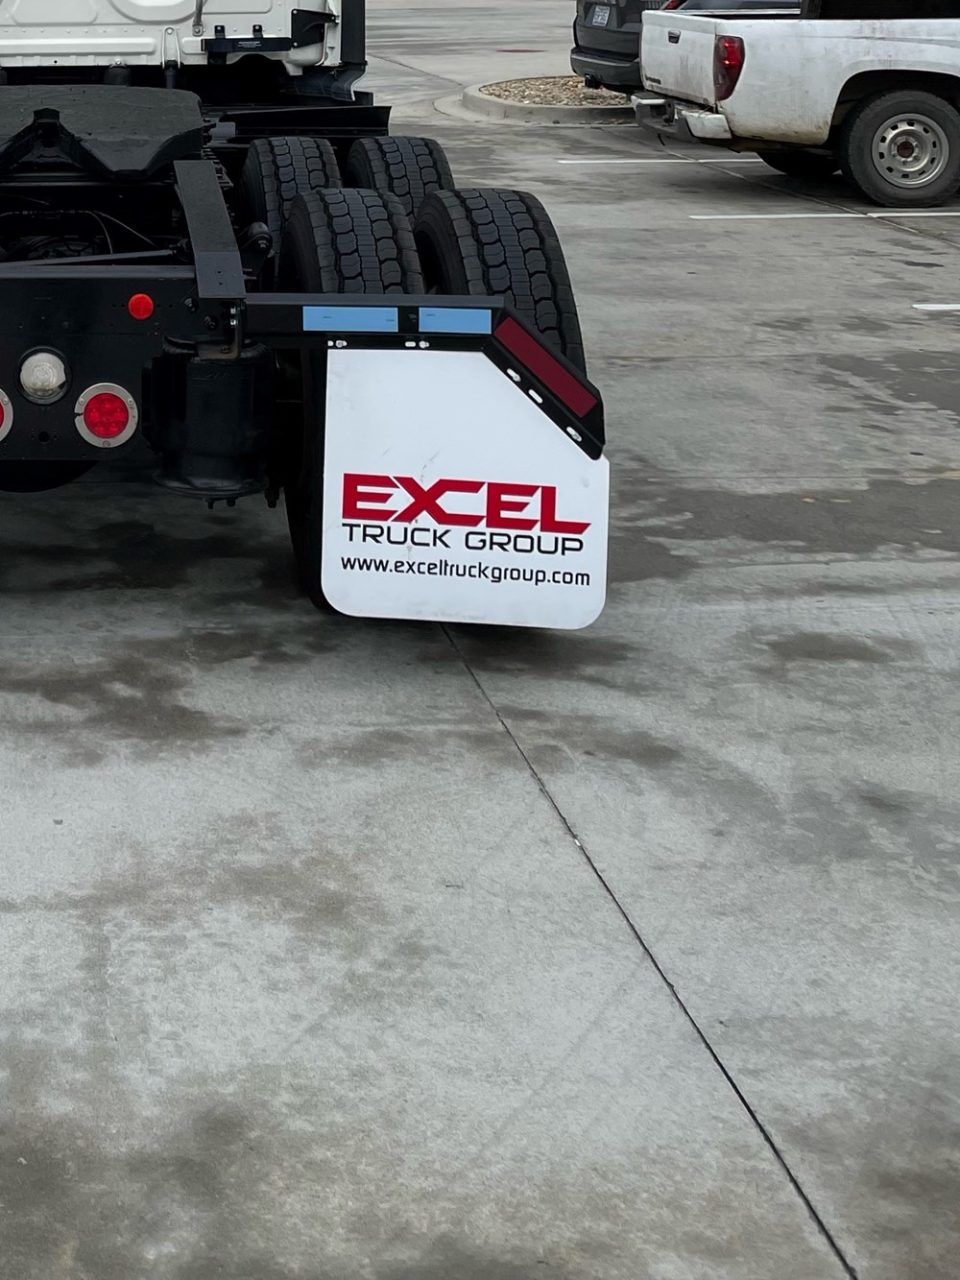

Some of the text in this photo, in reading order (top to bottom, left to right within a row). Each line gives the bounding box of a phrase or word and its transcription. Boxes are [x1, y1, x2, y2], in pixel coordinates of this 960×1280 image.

[342, 473, 592, 535] EXCEL
[342, 522, 584, 556] TRUCK GROUP
[341, 557, 590, 586] www.exceltruckgroup.com
